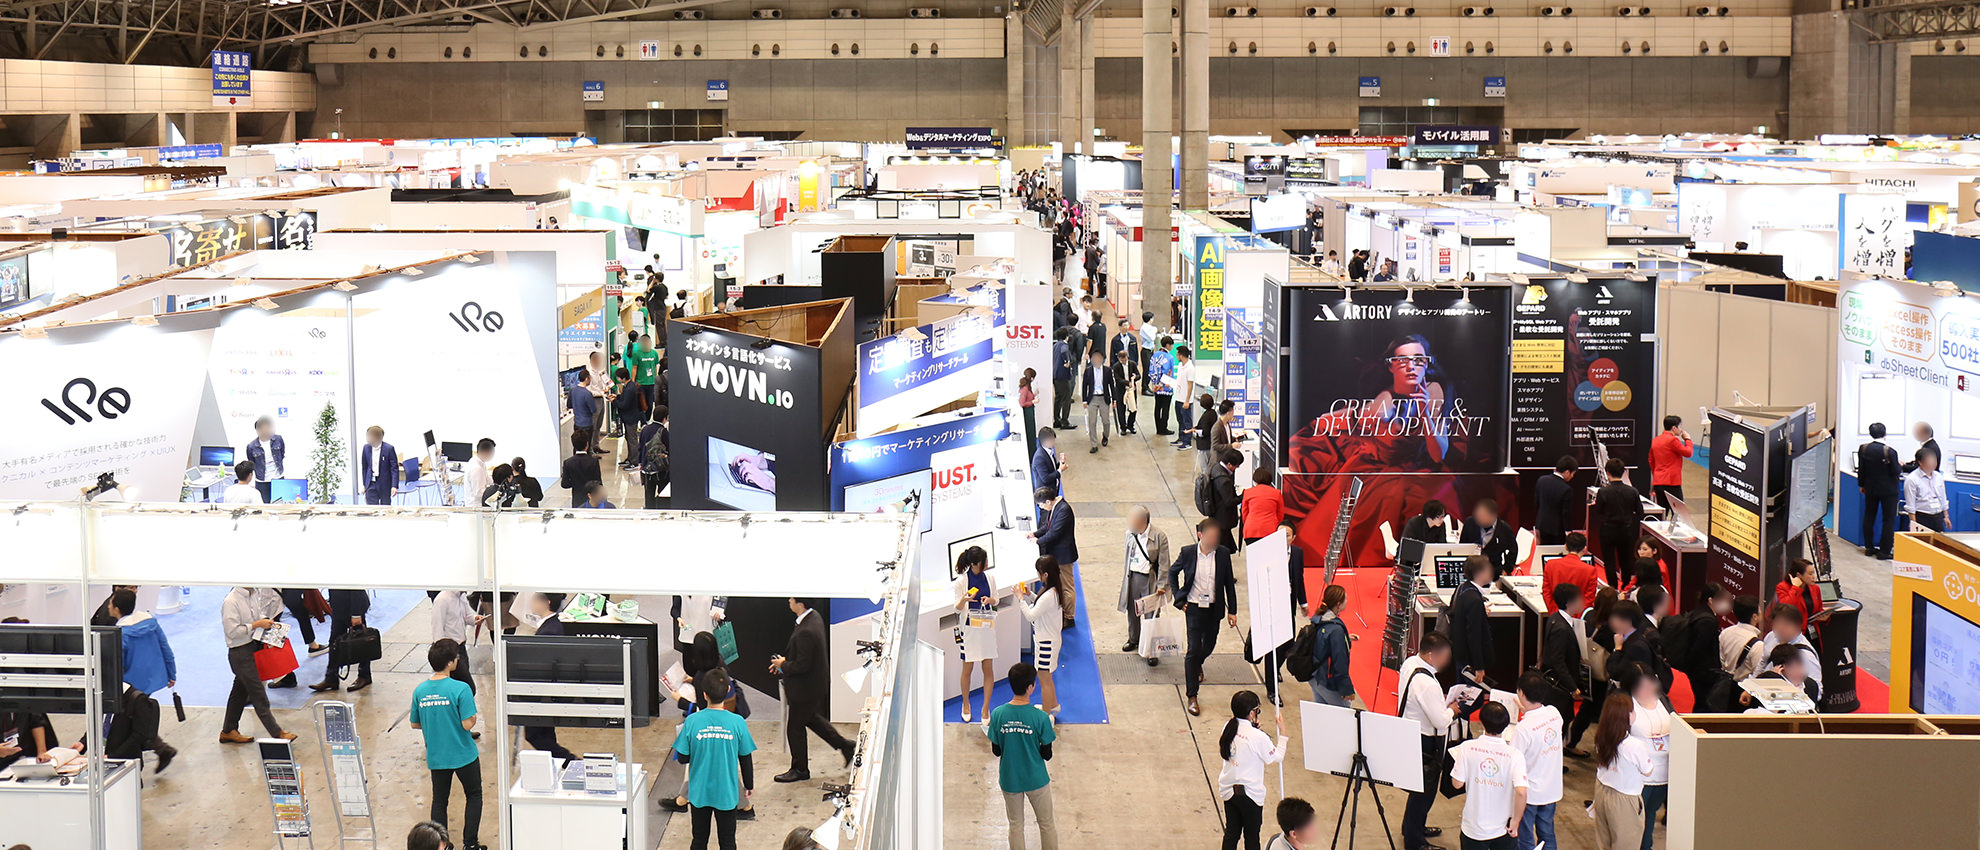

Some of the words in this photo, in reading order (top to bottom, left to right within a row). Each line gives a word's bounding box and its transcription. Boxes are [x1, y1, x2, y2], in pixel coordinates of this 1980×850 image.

[1422, 130, 1490, 141] モバイル活用展
[1865, 178, 1916, 188] HITACHI
[1344, 304, 1392, 320] ARTORY
[1516, 304, 1546, 312] GEPARD
[1588, 317, 1620, 326] 受託開発
[1844, 324, 1872, 340] そのまま
[1892, 337, 1923, 354] そのまま
[686, 338, 792, 371] オンライン多言語化サービス
[894, 352, 968, 388] マーケティングリサーチツール
[1330, 398, 1444, 418] CREATIVE
[1450, 398, 1468, 419] &
[1312, 417, 1490, 437] DEVELOPMENT
[1724, 454, 1747, 470] GEPARD
[1474, 776, 1504, 788] OutWork
